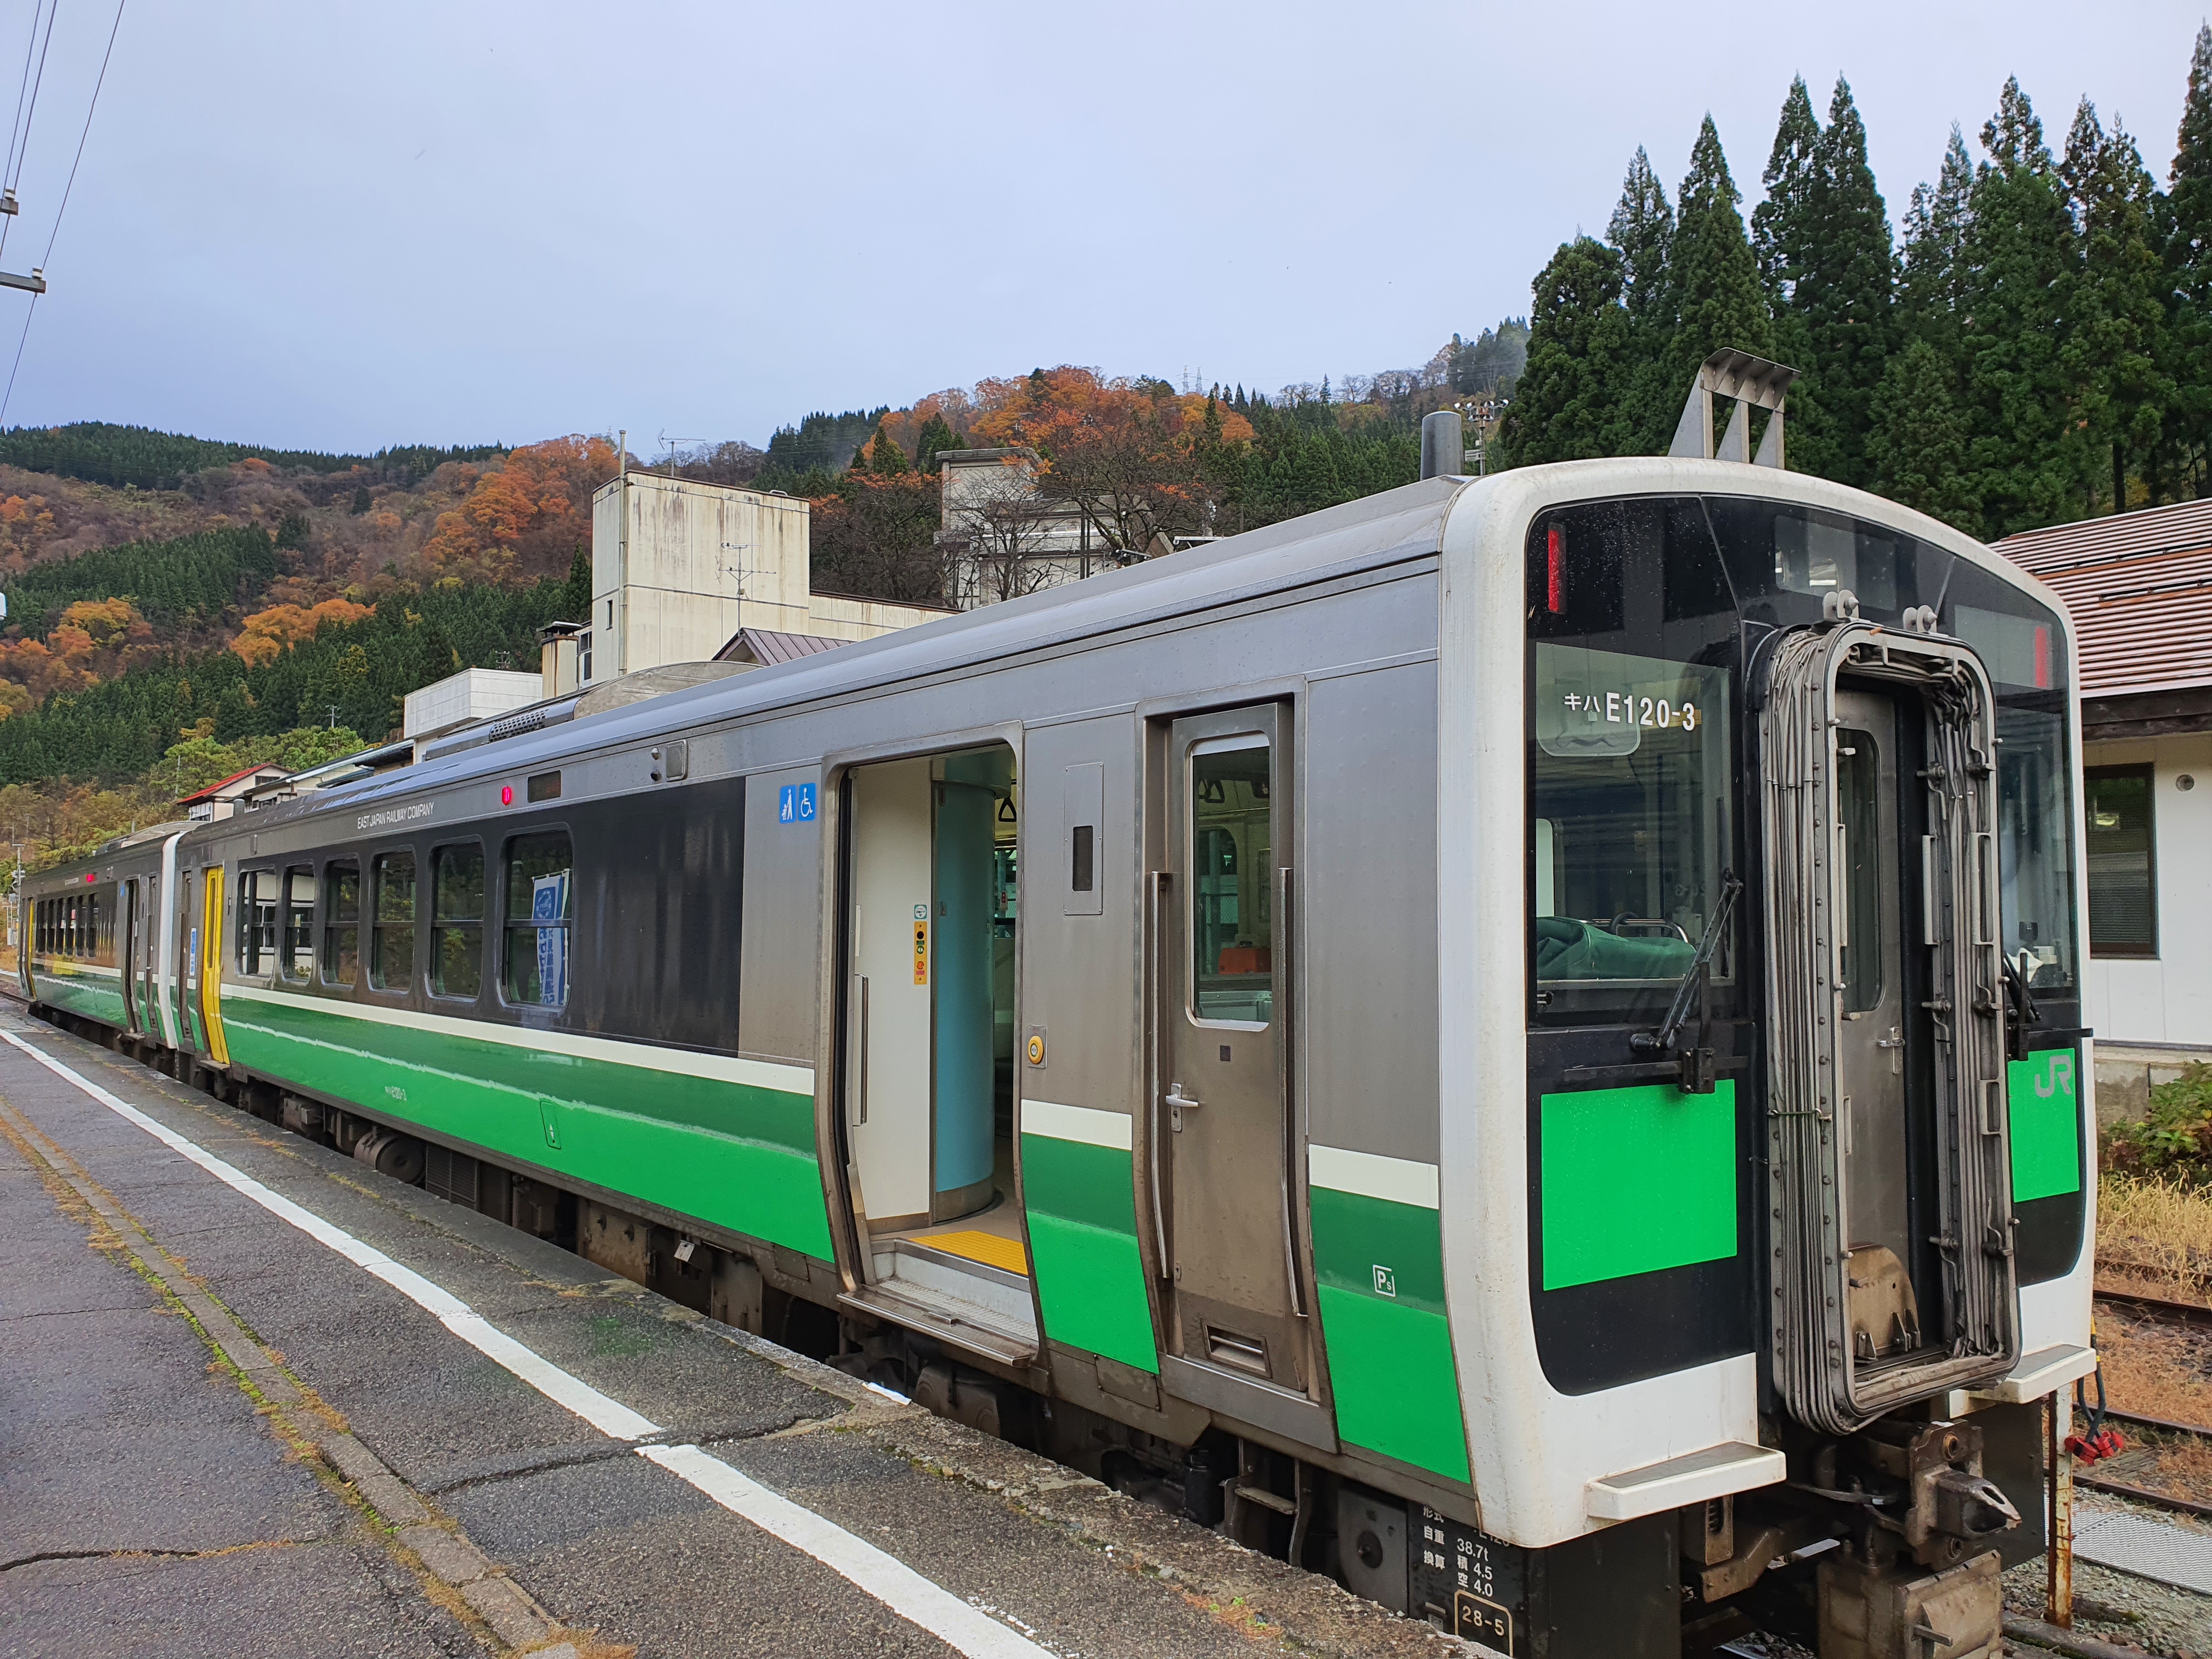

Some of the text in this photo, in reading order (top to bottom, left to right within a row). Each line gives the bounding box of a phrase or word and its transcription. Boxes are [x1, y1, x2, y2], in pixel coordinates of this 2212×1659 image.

[357, 802, 435, 830] EAST JAPAN RAILWAY COMPANY
[2035, 1055, 2072, 1098] JR
[1424, 1525, 1444, 1545] 自重
[1457, 1538, 1489, 1562] 38.7t
[1424, 1550, 1493, 1581] 換算 積 4.5
[1457, 1572, 1493, 1597] 空 4.0
[1462, 1605, 1505, 1637] 28-5
